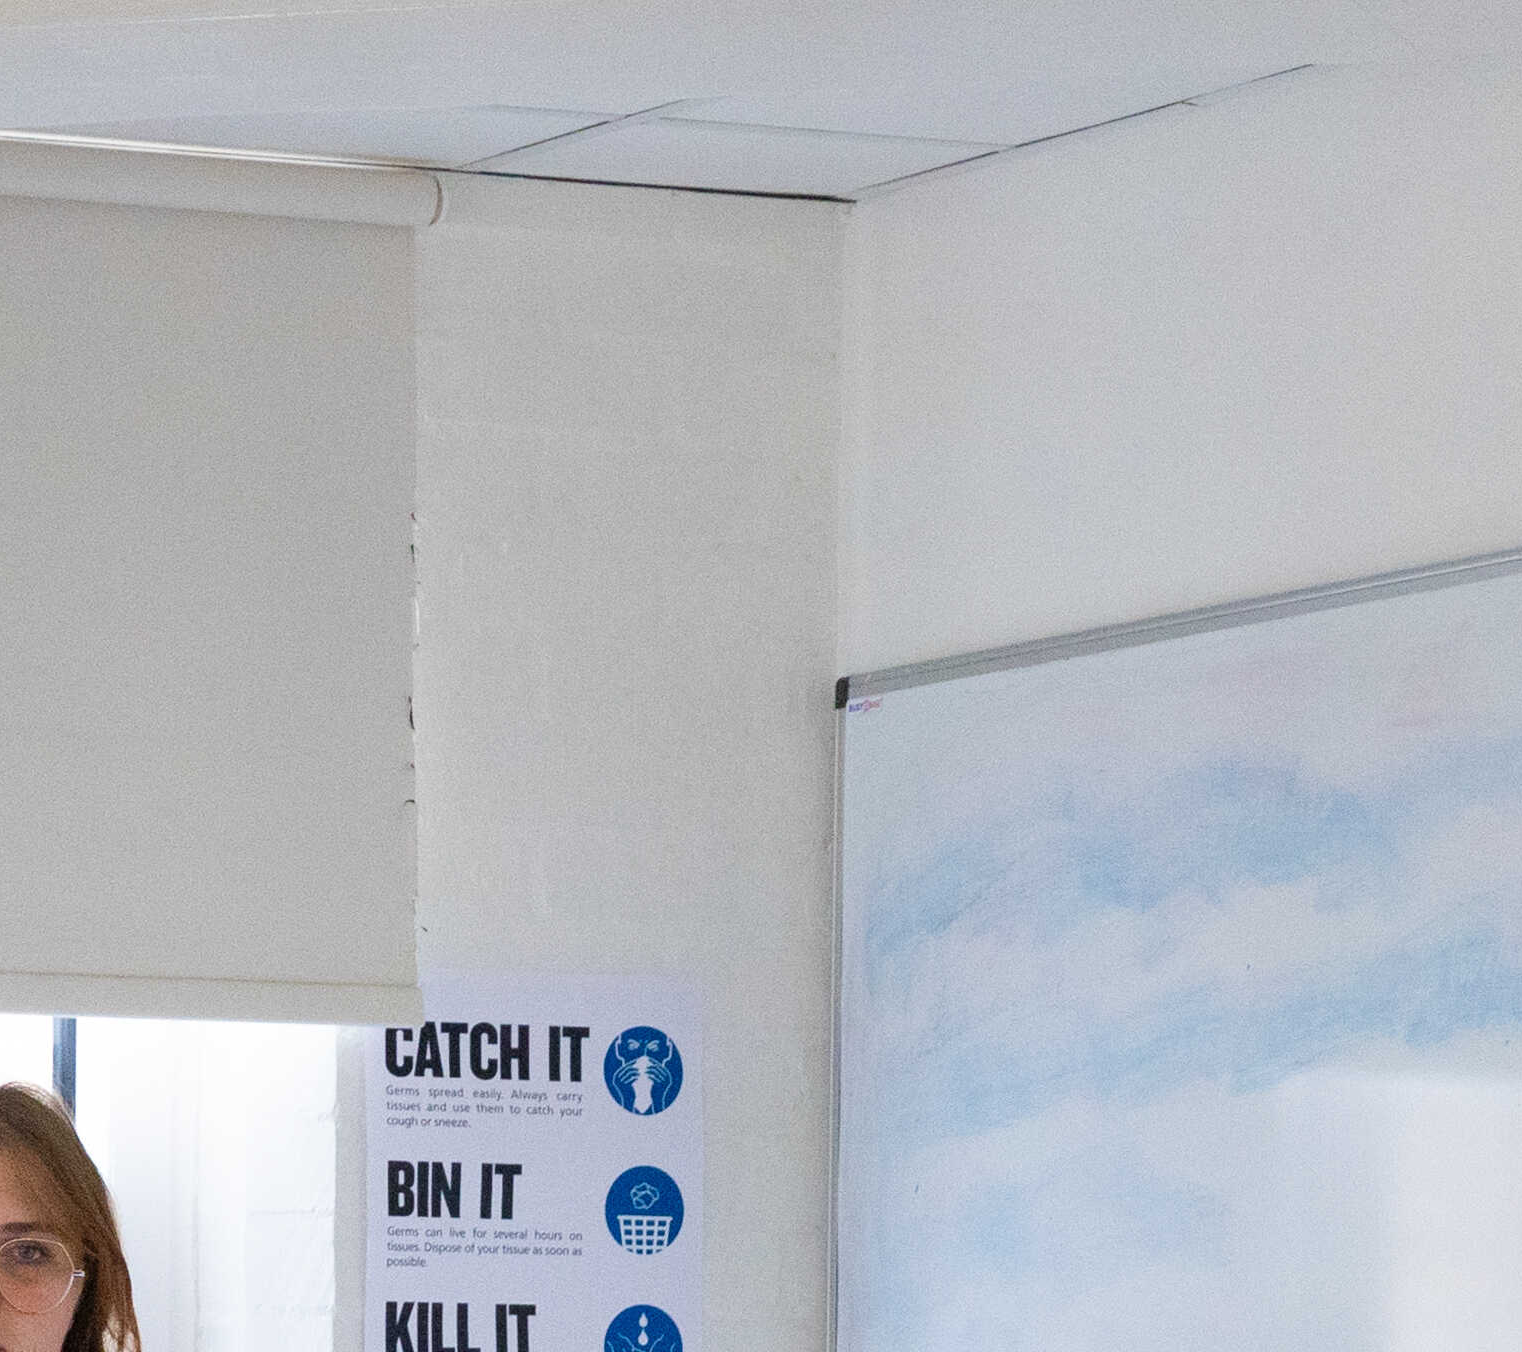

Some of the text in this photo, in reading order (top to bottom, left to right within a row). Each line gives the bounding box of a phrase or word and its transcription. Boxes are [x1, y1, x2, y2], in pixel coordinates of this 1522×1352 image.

[385, 1021, 591, 1082] CATCH IT
[386, 1085, 420, 1097] Germs
[428, 1087, 464, 1099] spread
[511, 1089, 548, 1103] Always
[556, 1092, 583, 1104] carry
[386, 1101, 583, 1117] tissues and use them to catch your
[386, 1117, 418, 1128] cough
[434, 1119, 471, 1128] sneeze.
[387, 1160, 523, 1220] BIN IT
[387, 1226, 583, 1241] Germs can live for several hours on
[425, 1242, 462, 1254] Dispose
[464, 1244, 476, 1253] of
[477, 1246, 498, 1255] your
[502, 1245, 529, 1255] tissue
[533, 1247, 543, 1255] as
[545, 1247, 569, 1256] soon
[572, 1248, 582, 1256] as
